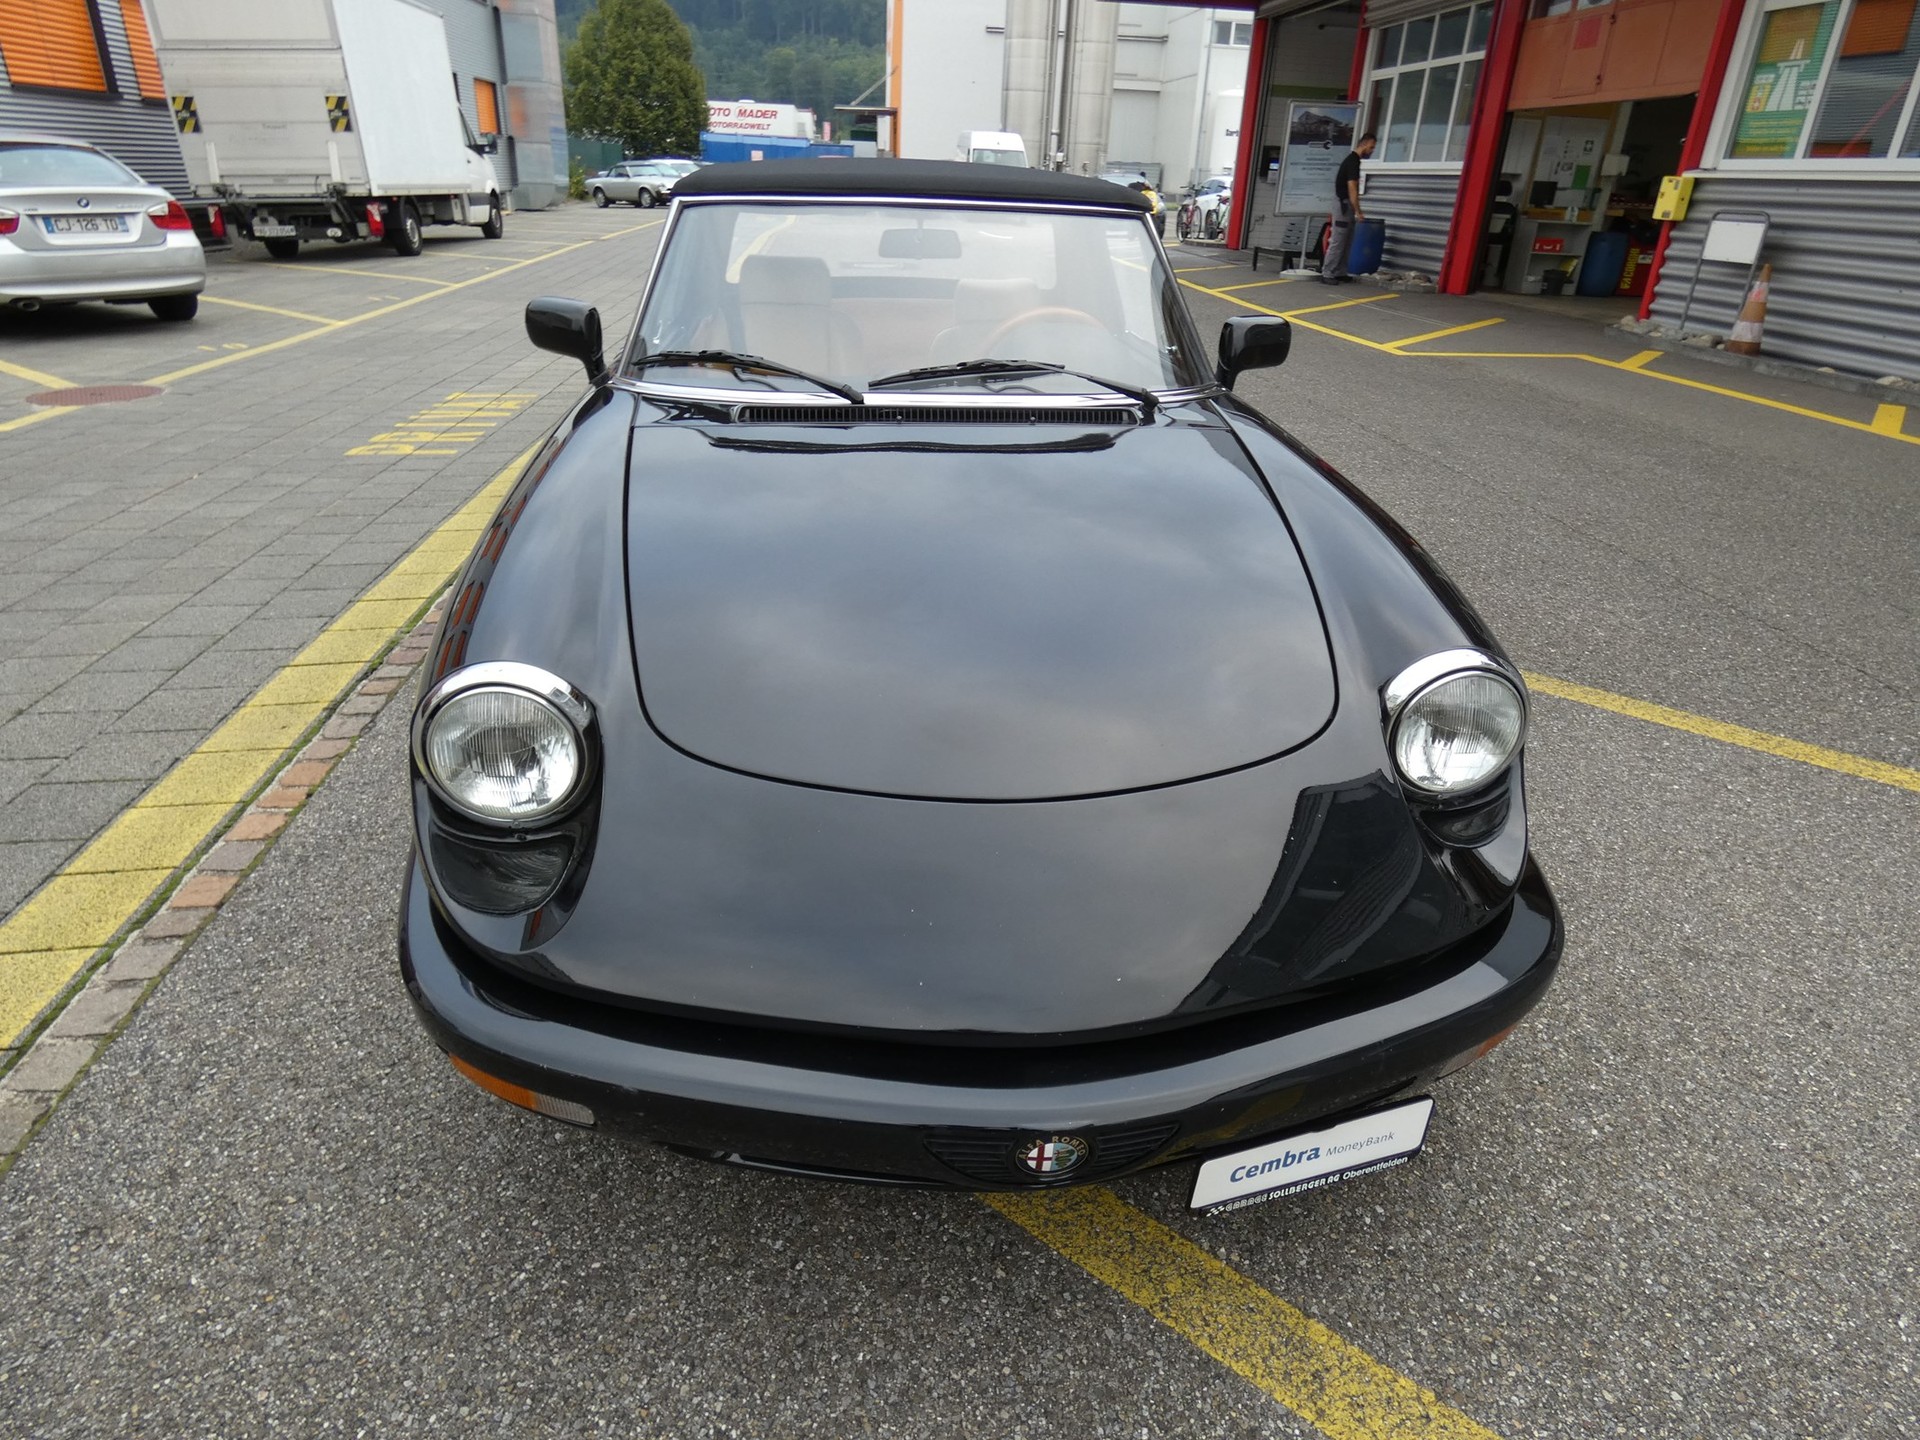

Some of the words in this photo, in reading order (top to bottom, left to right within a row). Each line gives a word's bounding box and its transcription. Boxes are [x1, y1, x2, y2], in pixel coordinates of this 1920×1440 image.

[709, 107, 731, 117] OTO
[737, 108, 778, 119] MADER
[1018, 1139, 1044, 1160] ALFA
[1052, 1135, 1086, 1156] ROMEO
[1229, 1146, 1321, 1183] Cembra
[1325, 1131, 1395, 1157] MoneyBank
[1268, 1178, 1326, 1200] SOLLBERGER
[1327, 1173, 1340, 1184] AG
[1342, 1156, 1408, 1180] Oberentfelden
